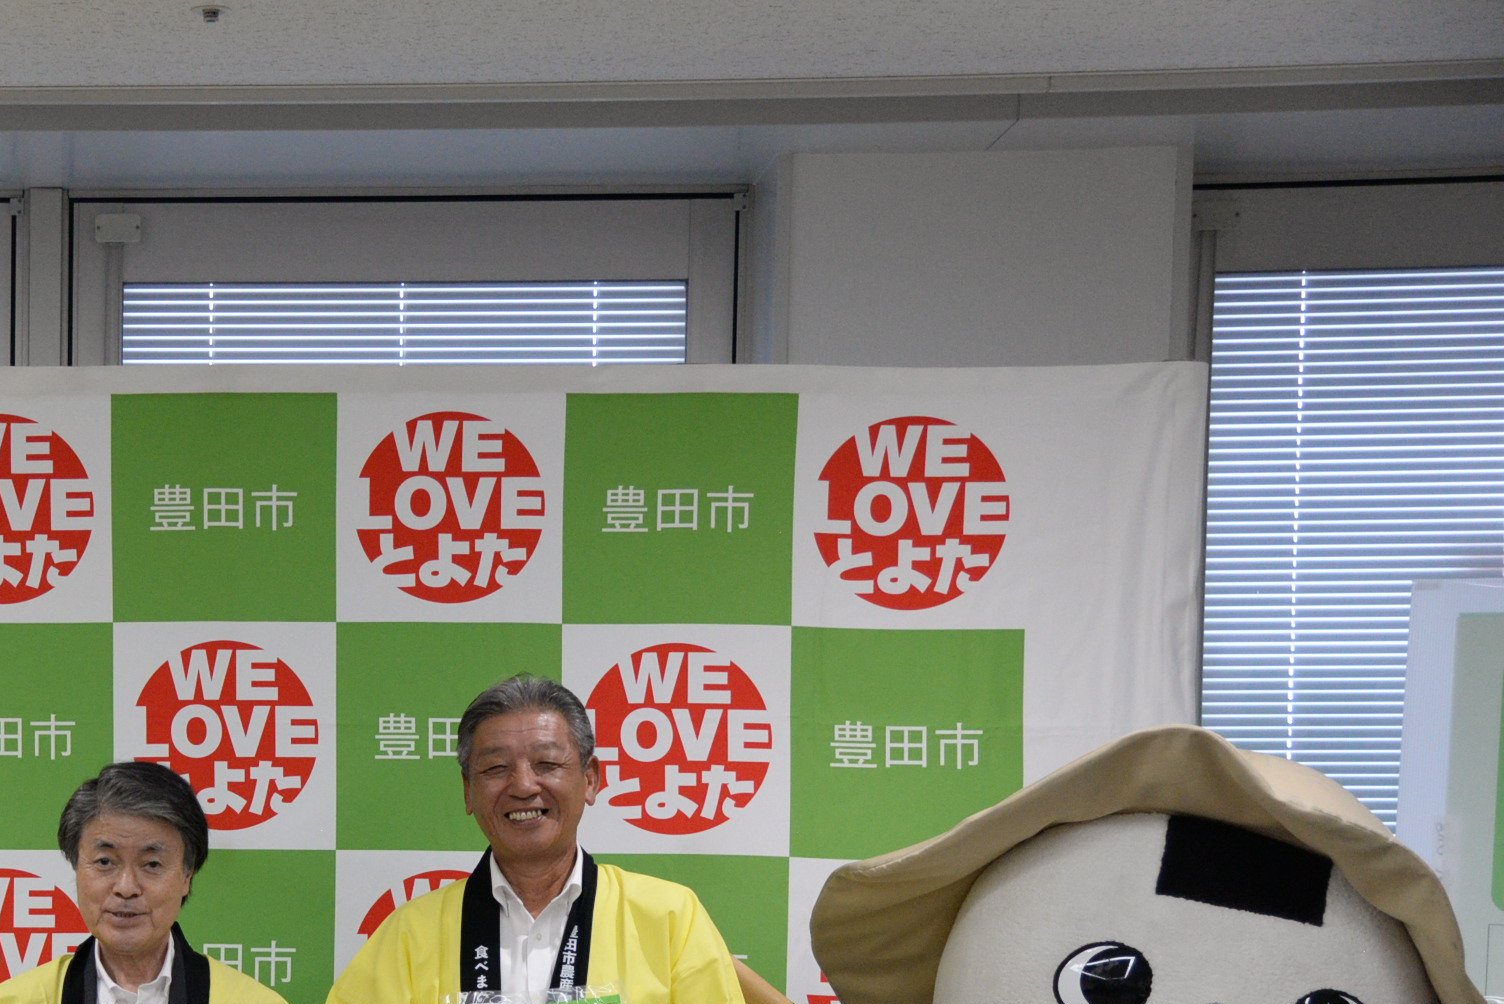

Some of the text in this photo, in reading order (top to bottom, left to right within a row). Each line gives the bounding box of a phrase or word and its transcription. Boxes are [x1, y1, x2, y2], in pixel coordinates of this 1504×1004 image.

[394, 420, 505, 473] WE
[855, 424, 969, 478] WE
[149, 484, 298, 532] 豊田市
[358, 476, 546, 532] LOVE
[602, 484, 755, 533] 豊田市
[816, 481, 1010, 537] LOVE
[372, 533, 527, 588] とよた
[829, 538, 991, 595] とよた
[167, 648, 279, 701] WE
[617, 651, 732, 704] WE
[134, 704, 319, 759] LOVE
[374, 712, 460, 760] 豊田
[830, 720, 984, 770] 豊田市
[157, 760, 302, 816] よた
[601, 764, 755, 820] とよた
[203, 940, 297, 987] 田市
